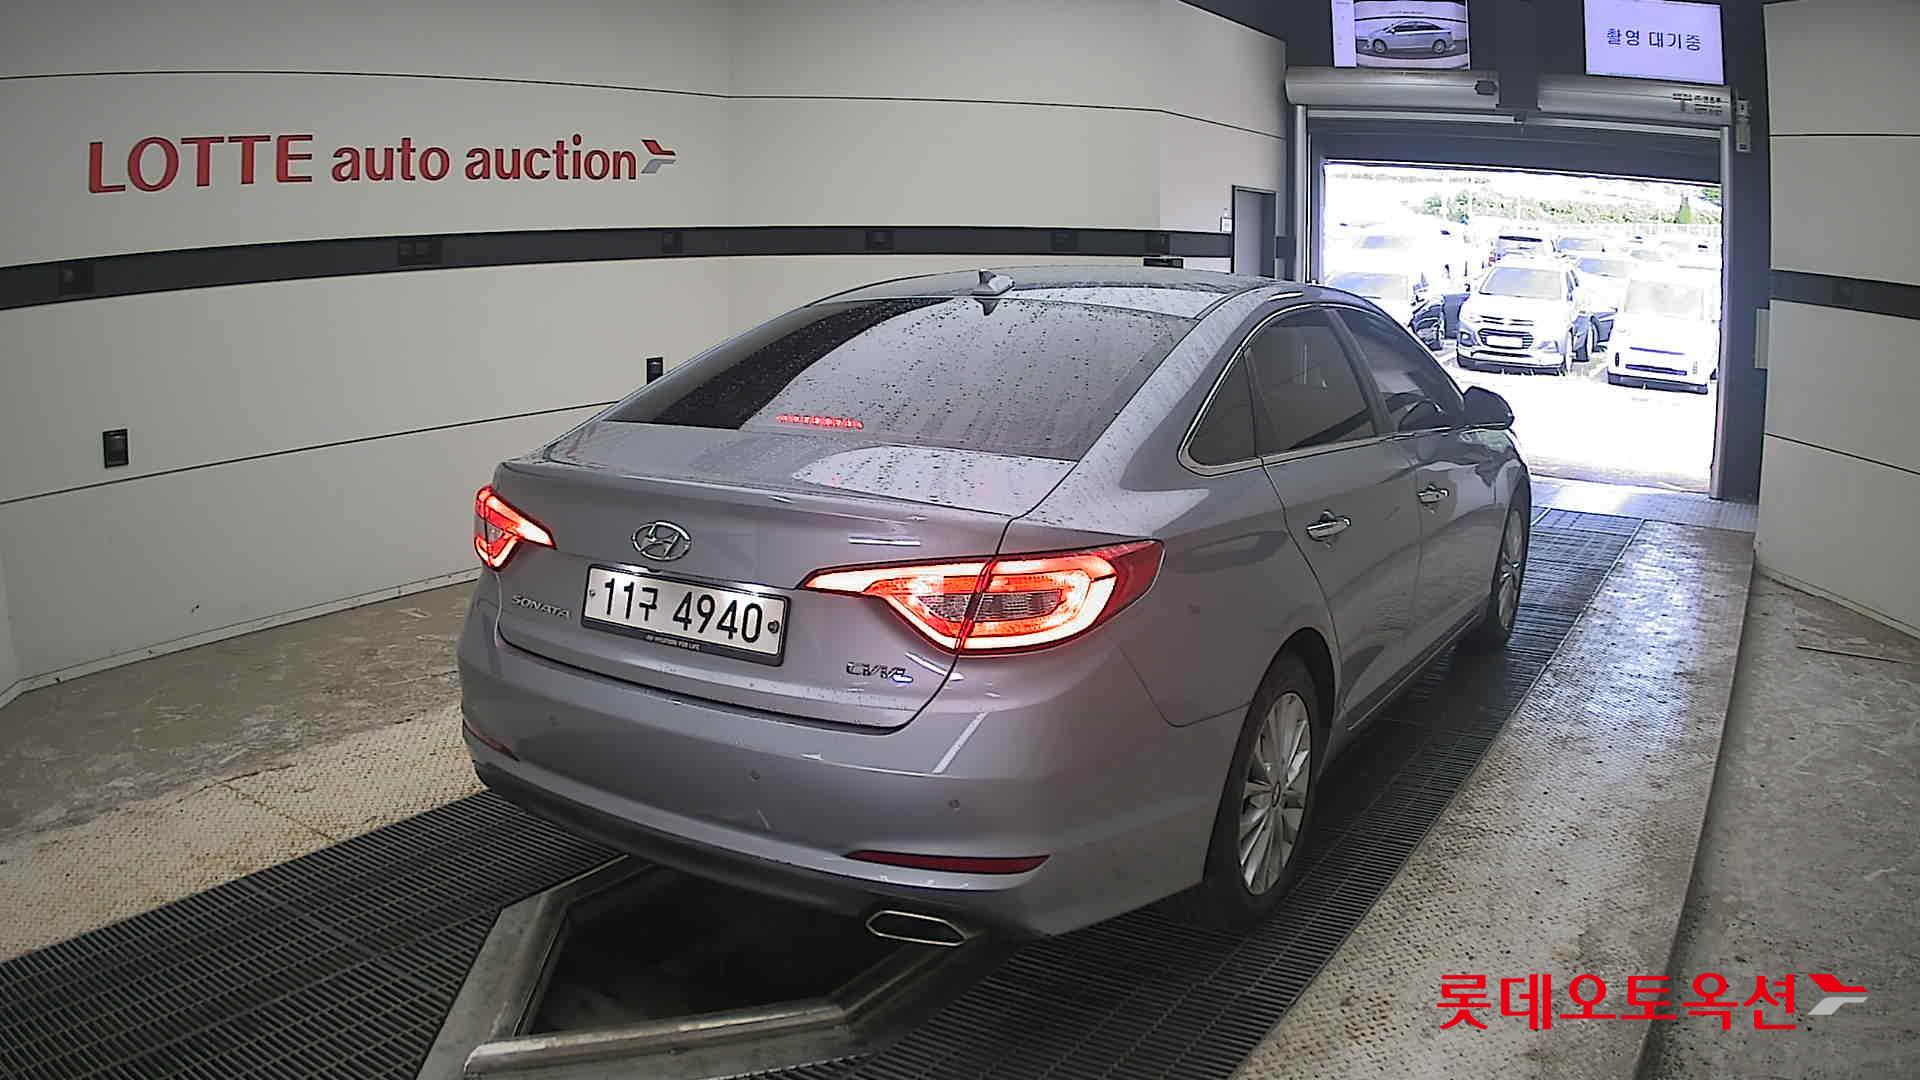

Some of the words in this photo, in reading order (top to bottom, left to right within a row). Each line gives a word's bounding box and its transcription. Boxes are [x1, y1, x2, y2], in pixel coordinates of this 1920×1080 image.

[1607, 28, 1640, 46] 촬영
[1648, 31, 1701, 51] 대기중
[88, 134, 313, 194] LOTTE
[331, 137, 450, 181] auto
[464, 133, 638, 181] auction
[511, 594, 570, 617] SONATA
[604, 577, 659, 622] 11구
[672, 591, 763, 643] 4940
